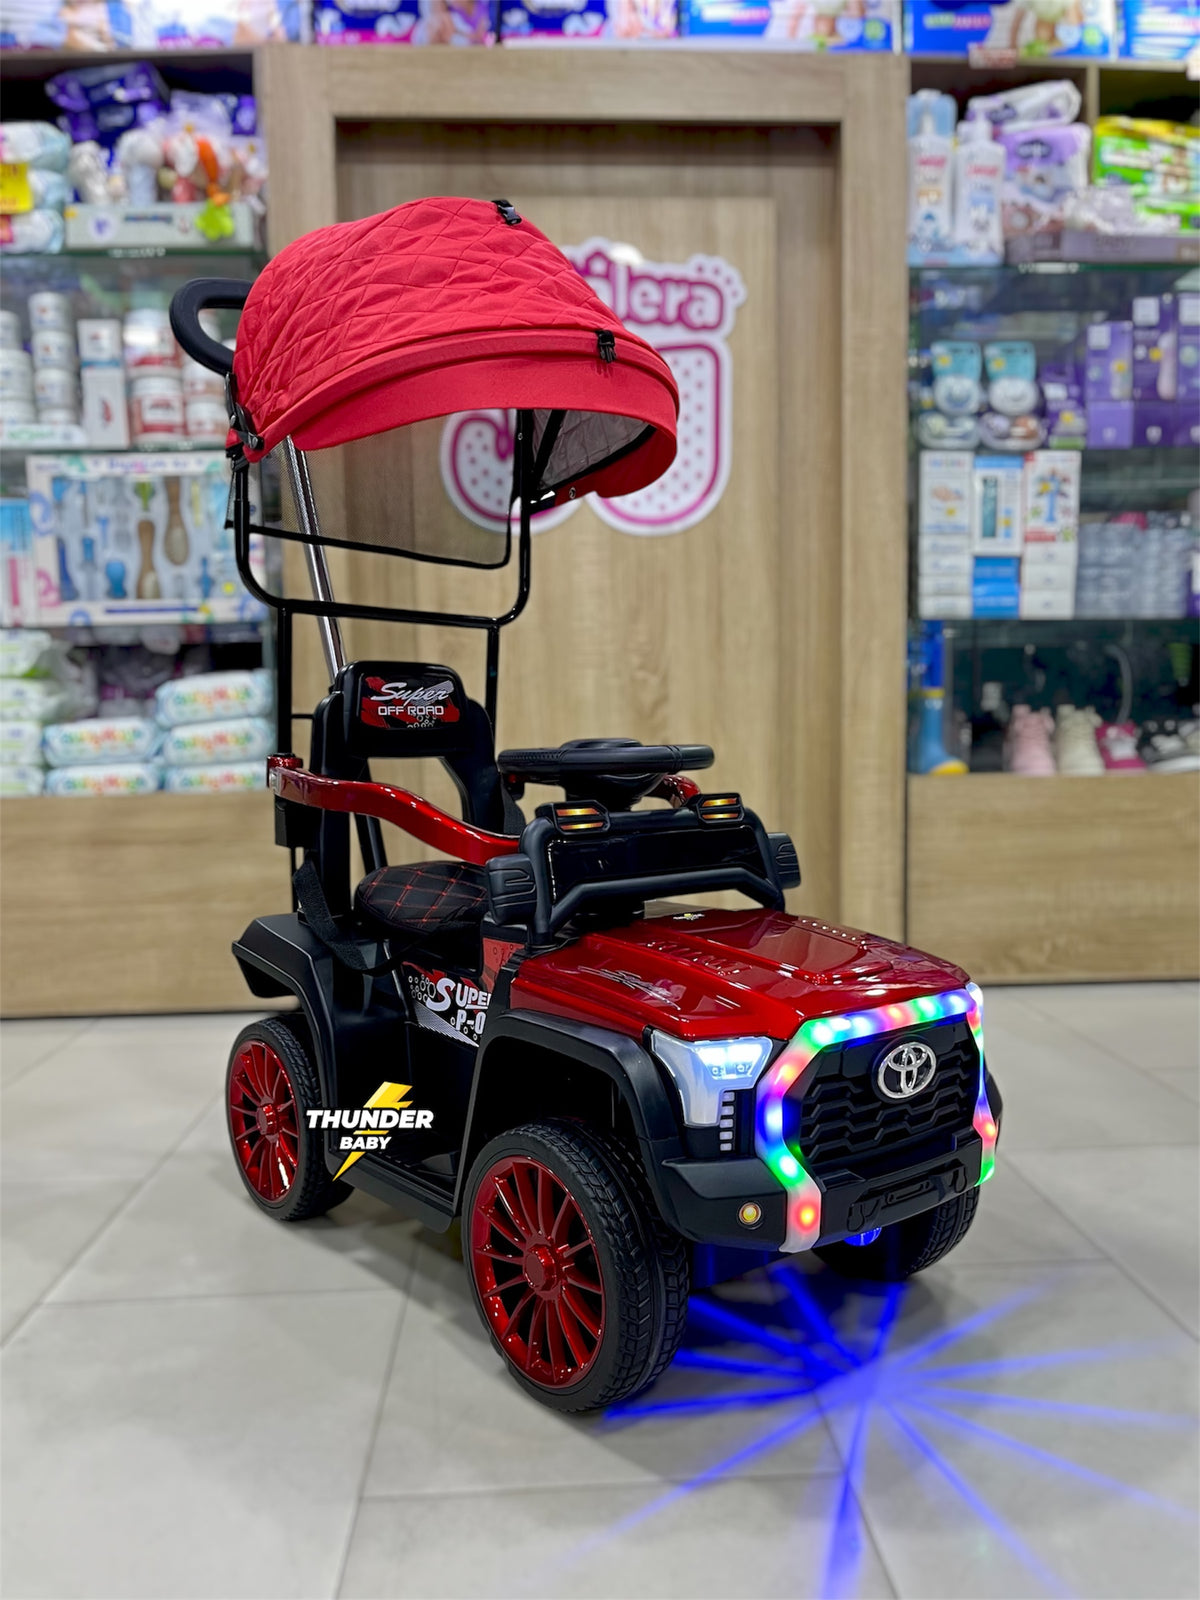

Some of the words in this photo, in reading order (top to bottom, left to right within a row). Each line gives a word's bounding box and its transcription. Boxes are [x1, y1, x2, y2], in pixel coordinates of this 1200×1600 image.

[370, 682, 449, 706] Super
[378, 705, 405, 716] OFF
[408, 705, 445, 716] ROAD
